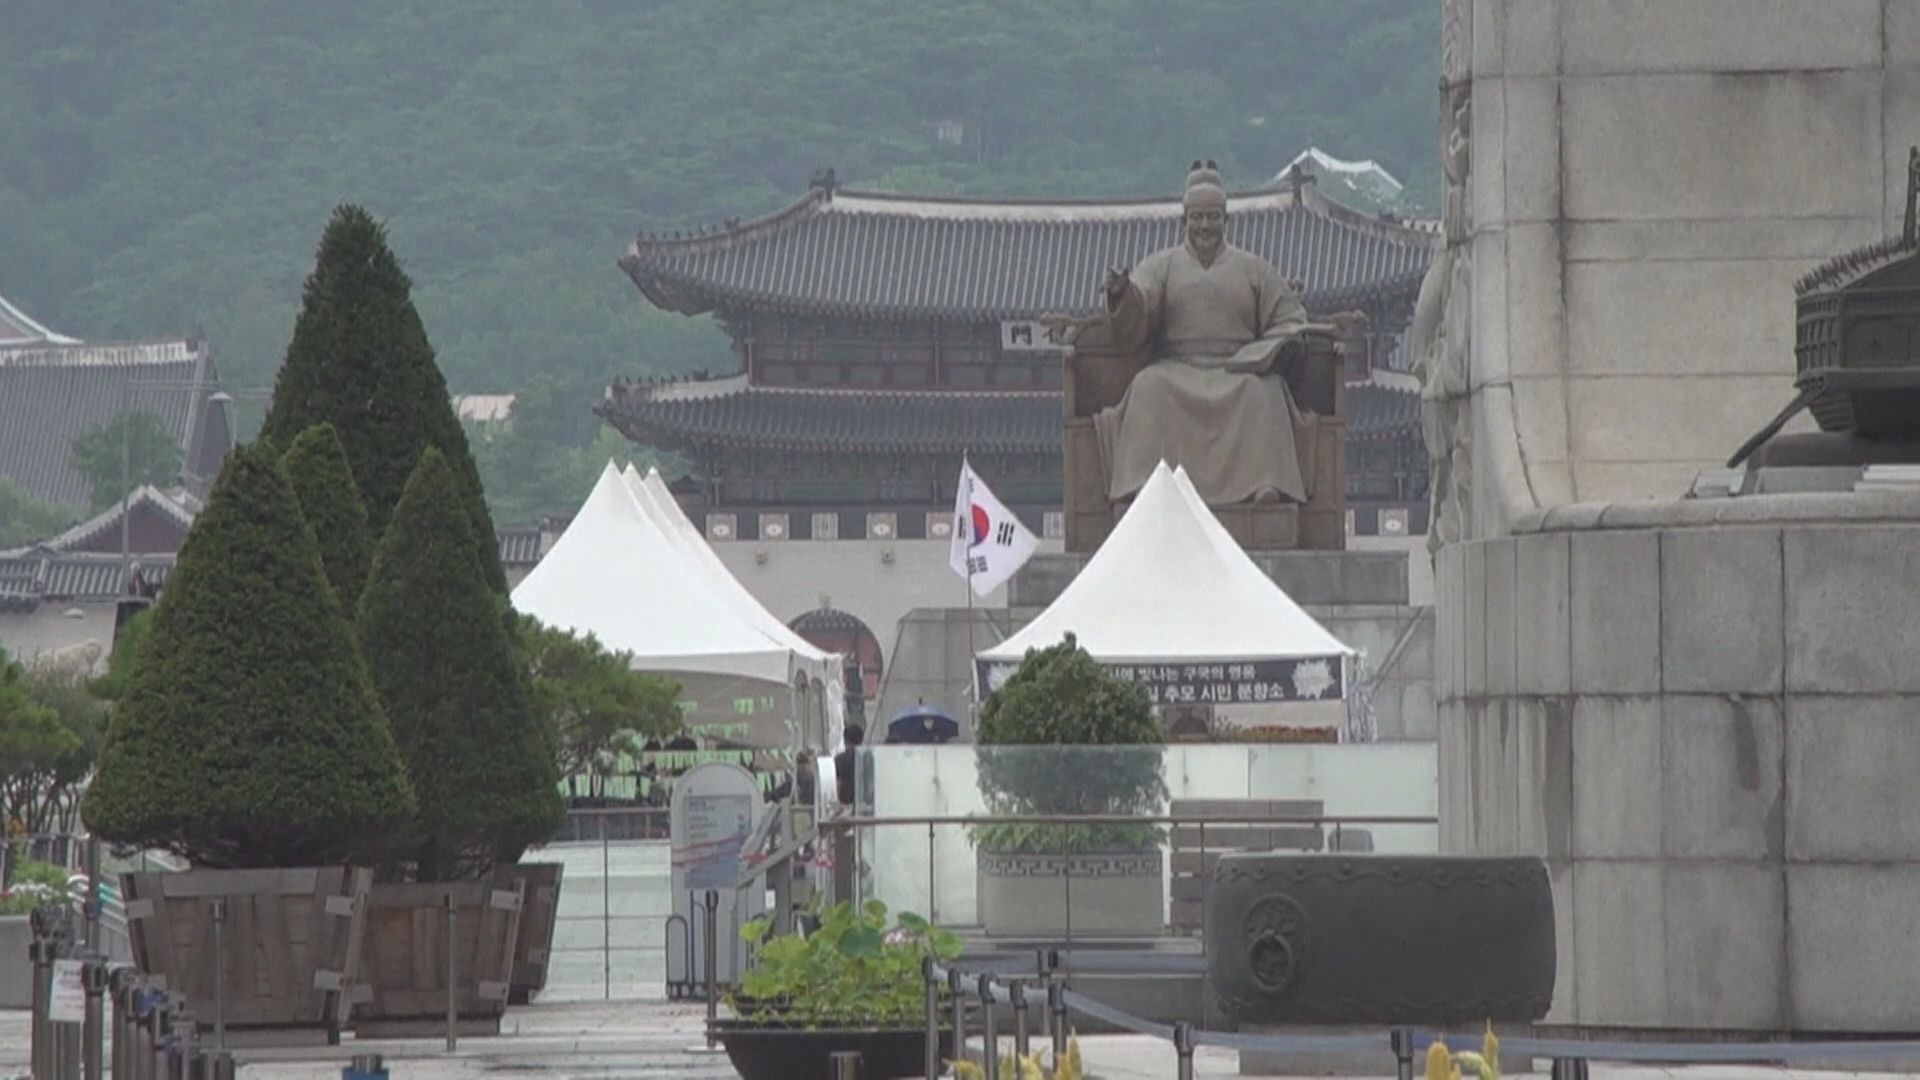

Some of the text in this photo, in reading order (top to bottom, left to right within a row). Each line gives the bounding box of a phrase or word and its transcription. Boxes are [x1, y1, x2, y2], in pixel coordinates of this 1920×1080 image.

[1138, 666, 1178, 682] 빛나는
[1183, 666, 1224, 682] 구국의
[1228, 664, 1256, 680] 영웅
[1164, 684, 1196, 702] 추모
[1201, 682, 1232, 702] 시민
[1237, 681, 1285, 701] 분향소
